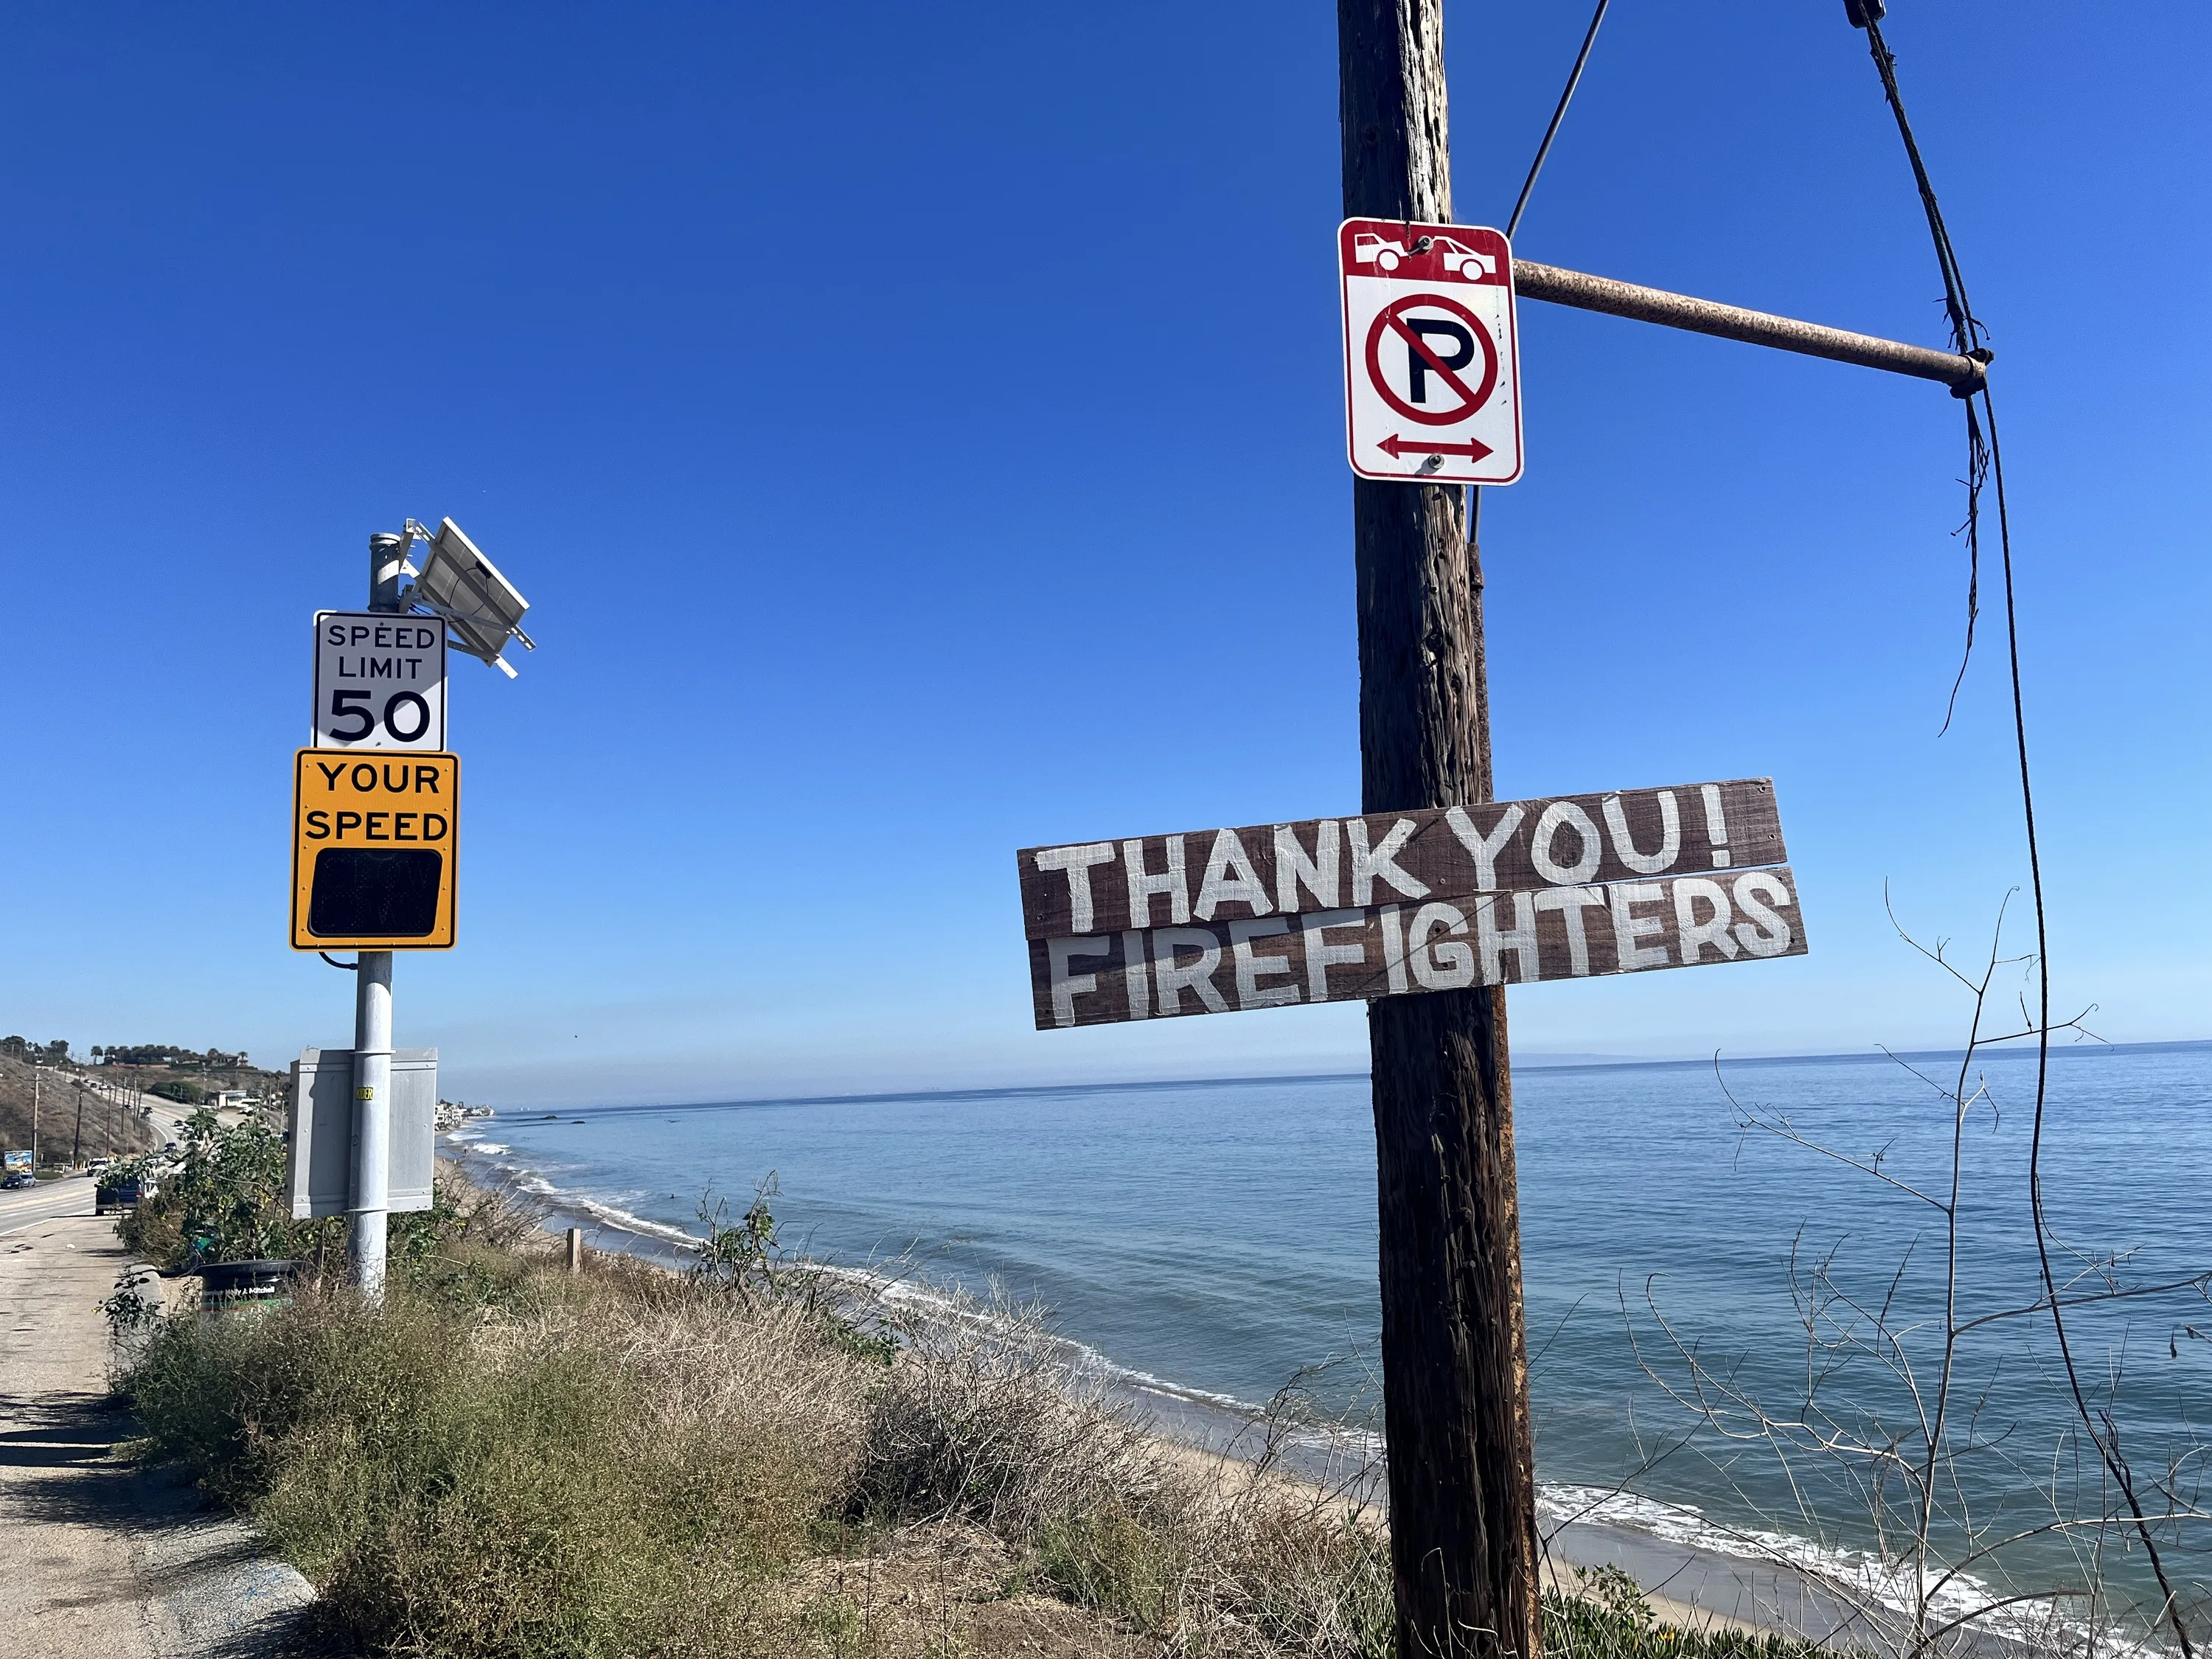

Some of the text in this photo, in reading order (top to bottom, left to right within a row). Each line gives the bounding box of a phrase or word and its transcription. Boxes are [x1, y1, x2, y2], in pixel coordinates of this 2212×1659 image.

[1406, 318, 1475, 404] P
[327, 625, 436, 650] SPEED
[338, 655, 422, 680] LIMIT
[328, 689, 431, 742] 50
[316, 762, 440, 794] YOUR
[305, 810, 448, 841] SPEED
[1036, 784, 1731, 933] THANK YOU!
[1046, 871, 1792, 1027] FIREFIGHTERS
[249, 1286, 275, 1294] Mitchell
